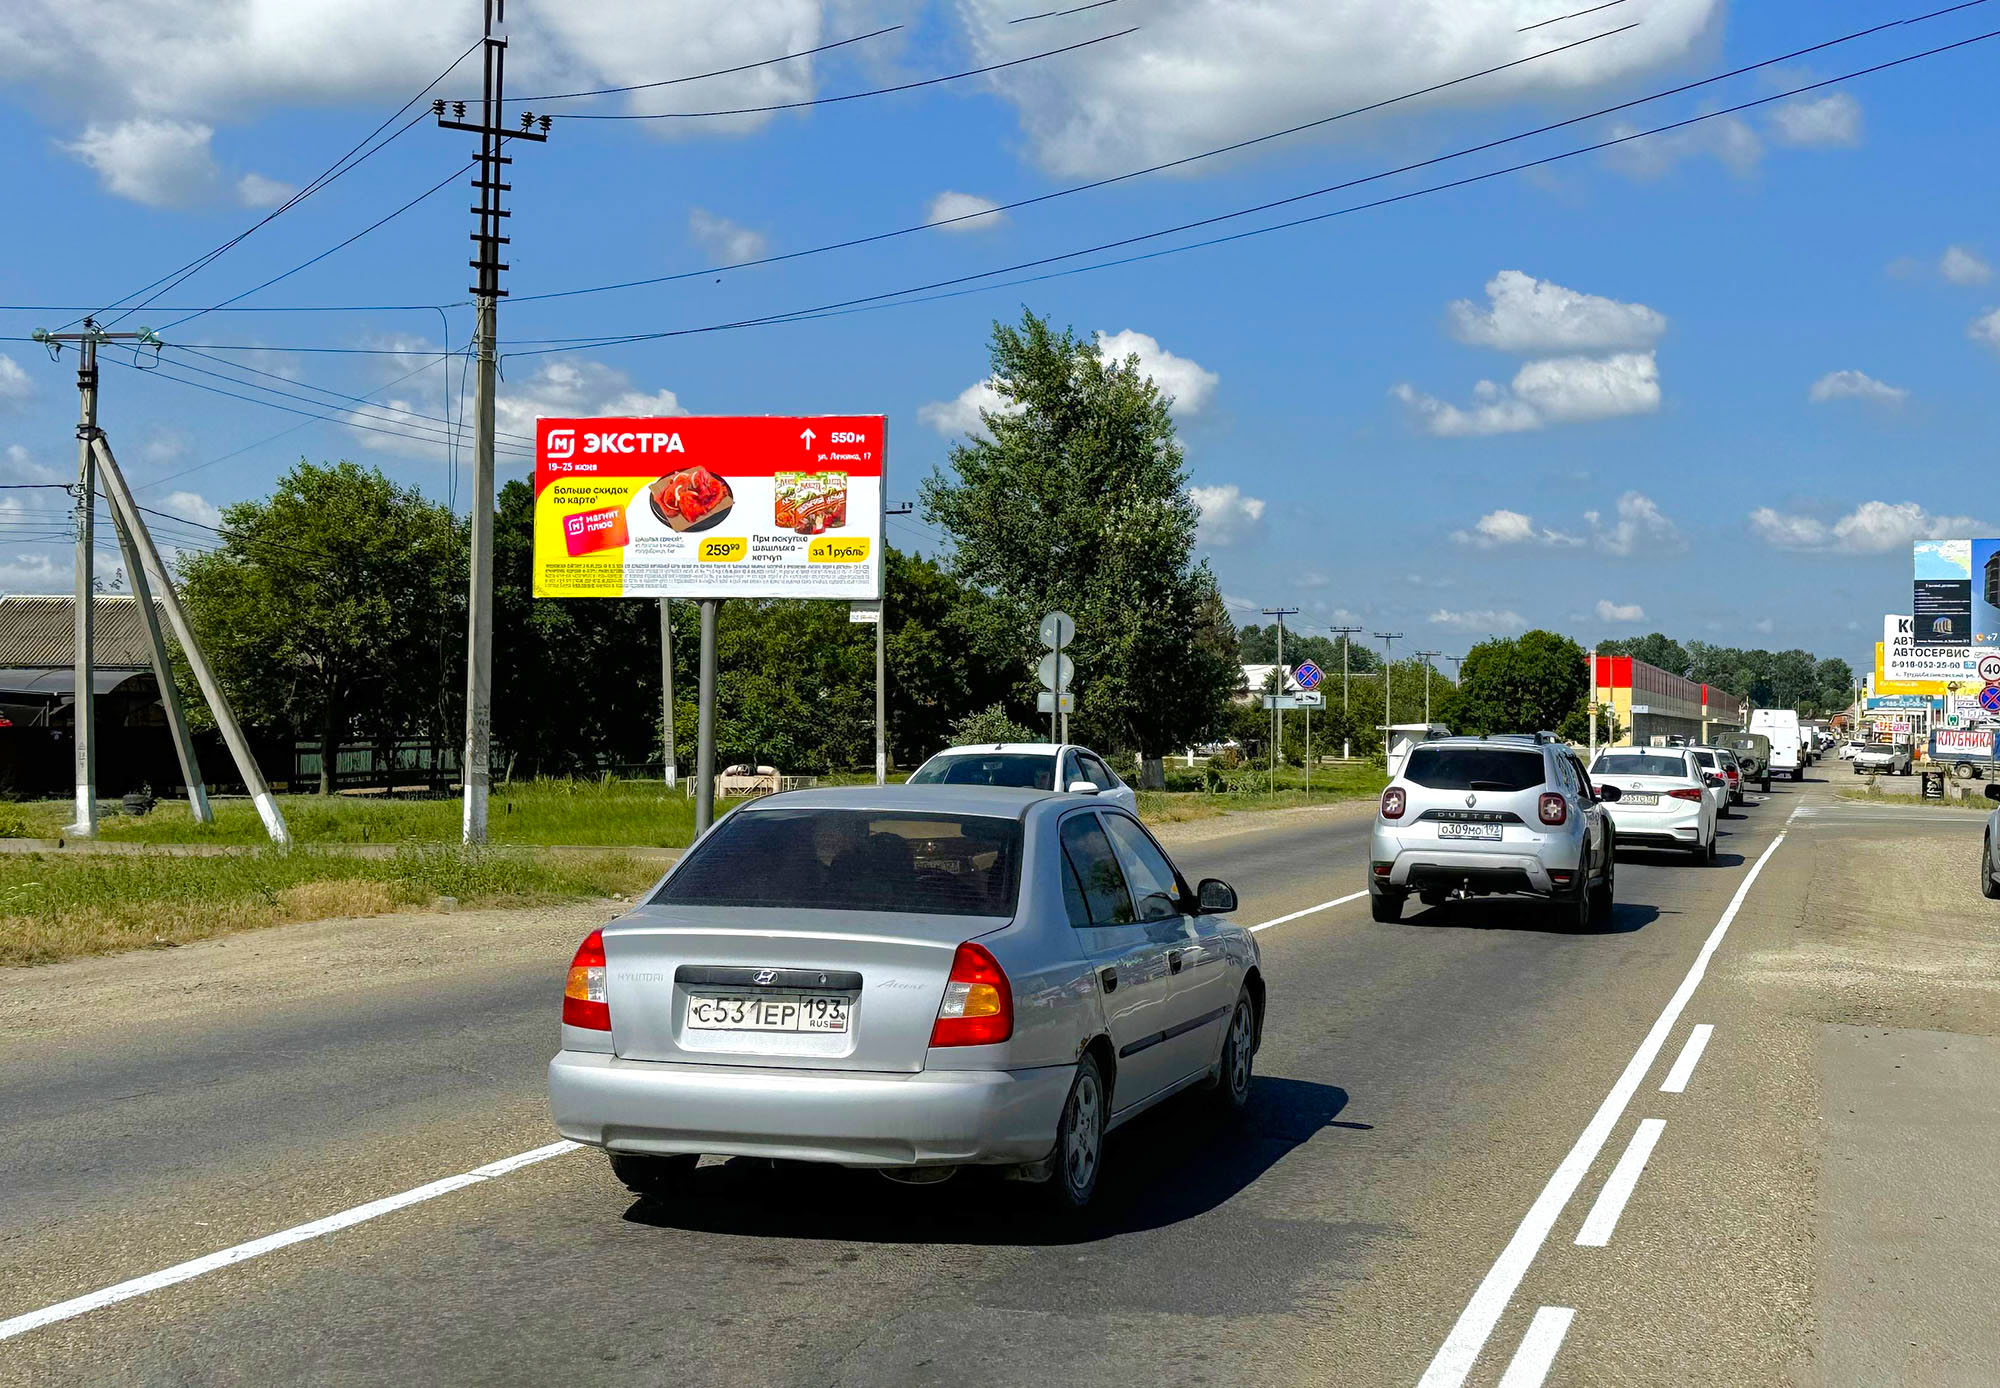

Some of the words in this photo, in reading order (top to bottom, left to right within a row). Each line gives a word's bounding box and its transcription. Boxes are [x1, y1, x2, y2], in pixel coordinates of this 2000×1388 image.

[831, 431, 865, 443] 550м
[583, 432, 685, 454] ЭКСТРА
[554, 485, 592, 495] Больше
[593, 486, 629, 495] скидок
[553, 495, 566, 504] по
[752, 535, 771, 543] При
[771, 535, 808, 545] покупке
[812, 548, 825, 557] за
[751, 554, 783, 563] кетчуп
[1893, 647, 1970, 658] АВТОСЕРВИС
[1983, 663, 2000, 675] 40
[1937, 730, 1992, 748] КЛУБНИКА
[1437, 812, 1503, 820] DUSTER
[617, 972, 664, 982] HYUNDAI
[803, 998, 841, 1020] 193
[809, 1019, 829, 1028] RUS
